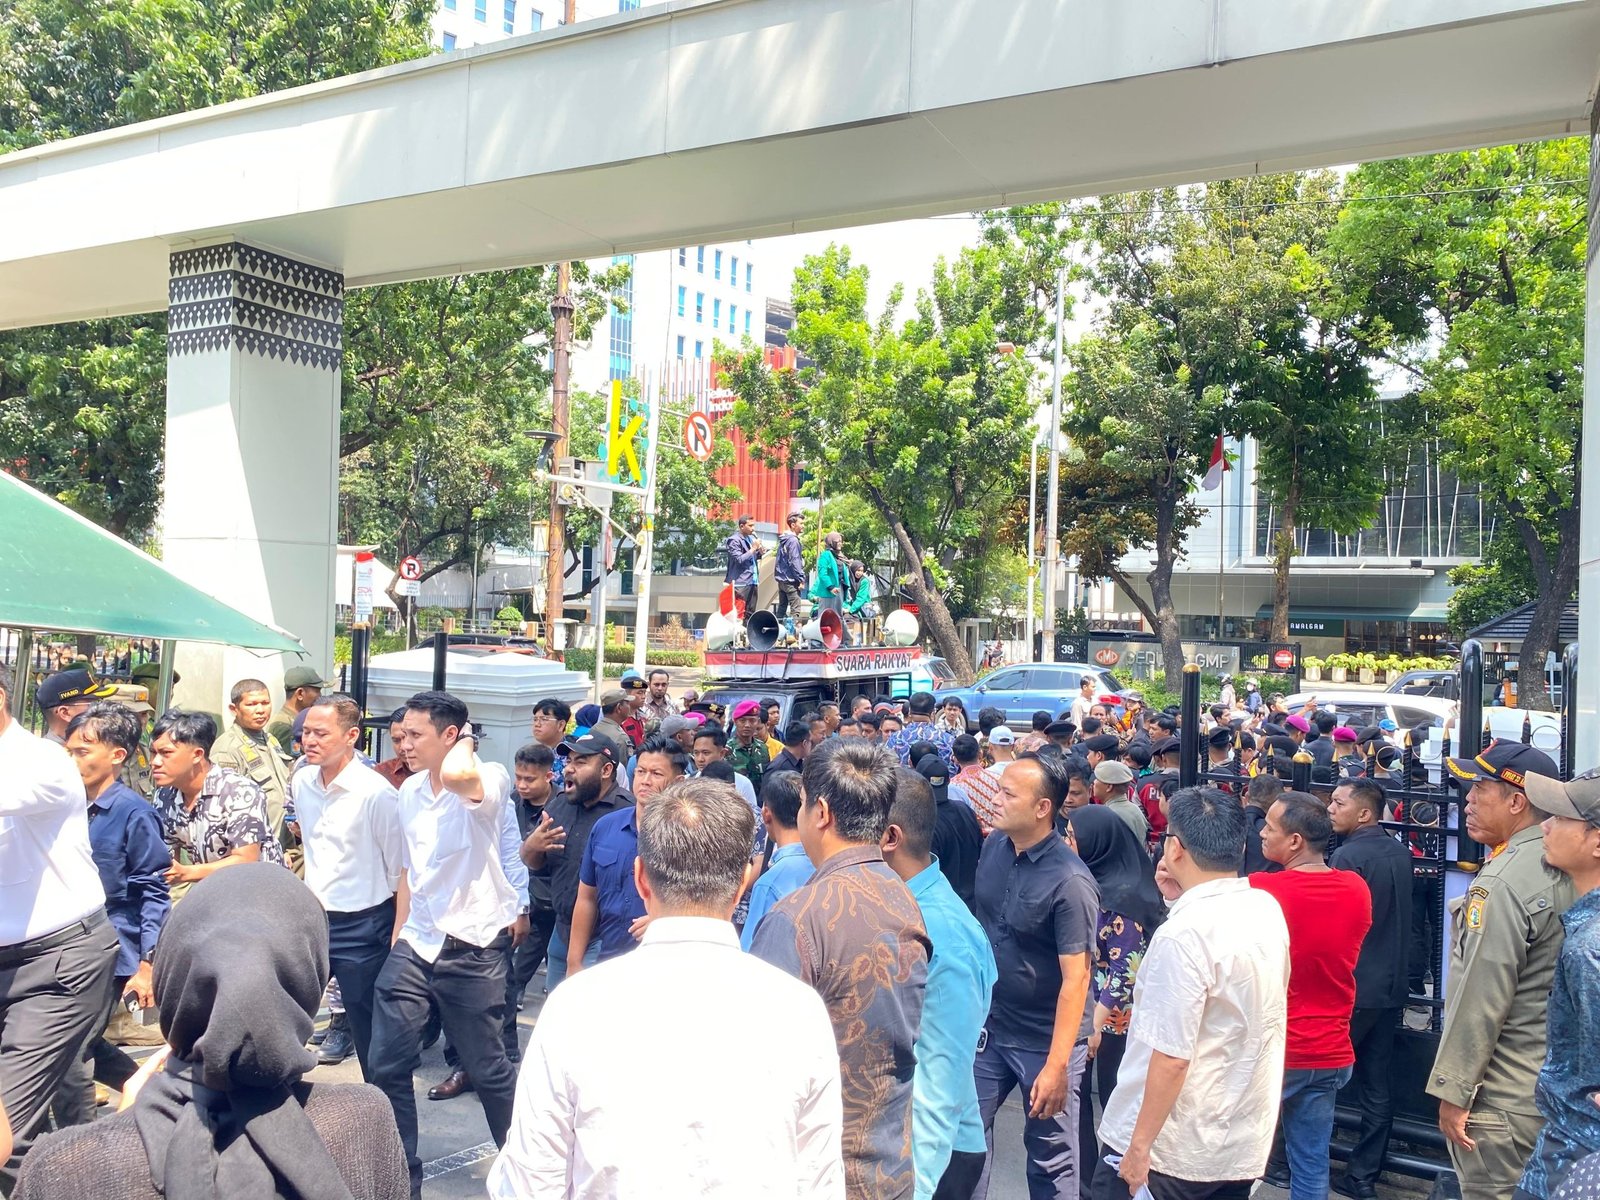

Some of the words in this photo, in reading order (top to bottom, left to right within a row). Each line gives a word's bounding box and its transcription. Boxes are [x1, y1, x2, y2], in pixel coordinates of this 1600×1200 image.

[1290, 622, 1324, 630] AMALGAM
[1061, 644, 1074, 654] 39
[836, 654, 871, 672] SUARA
[874, 652, 912, 669] RAKYAT
[1195, 653, 1230, 669] GMP
